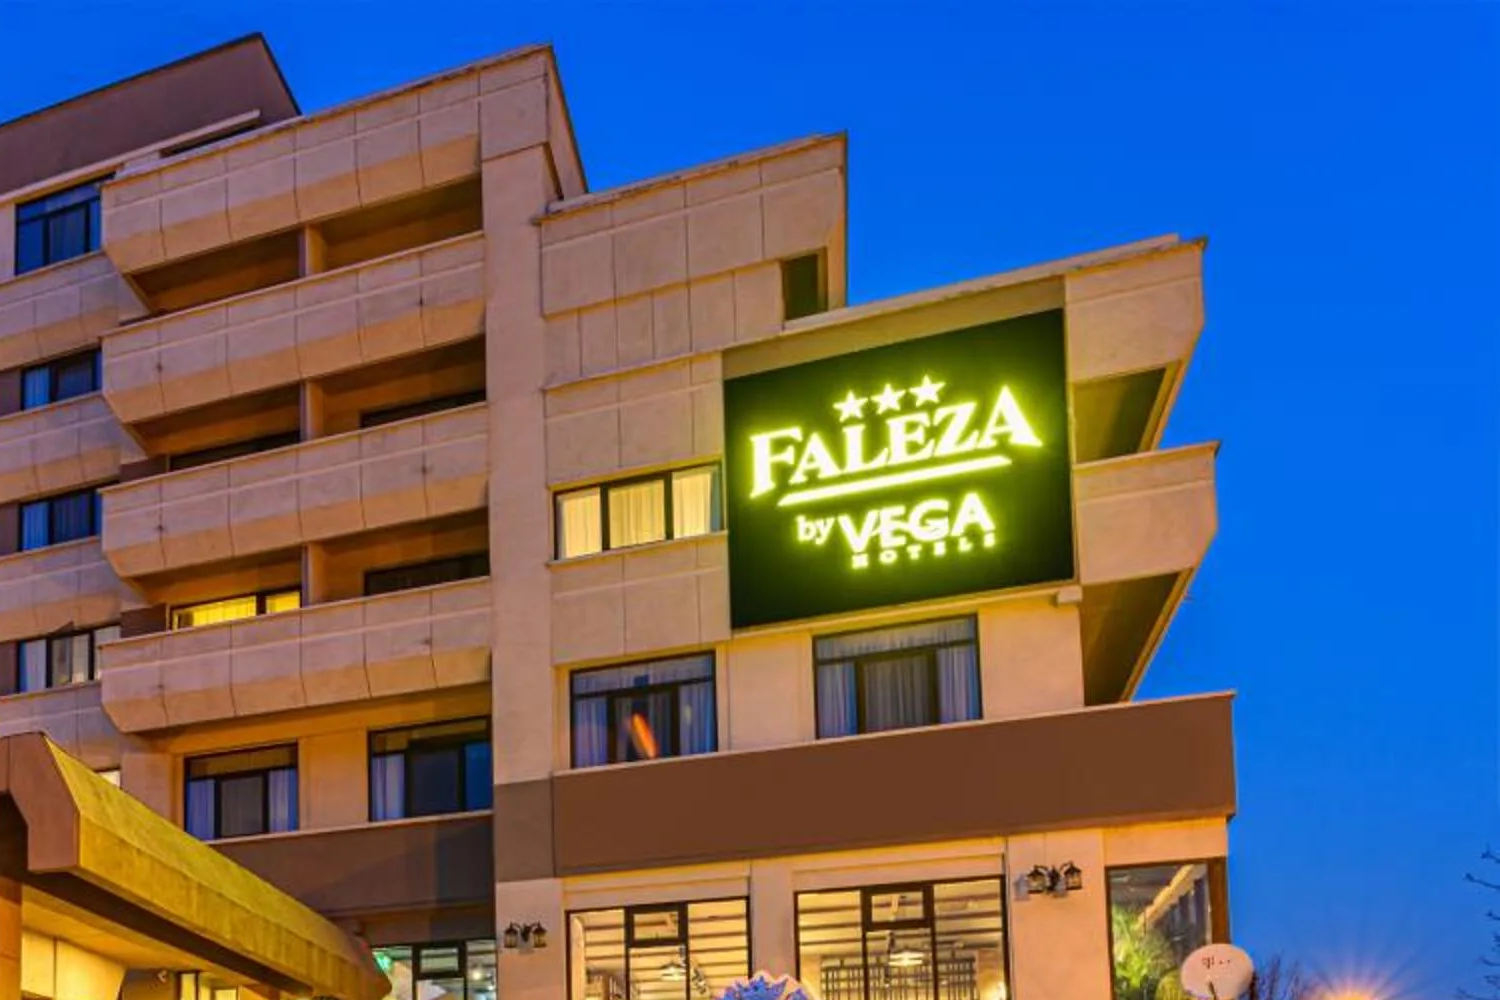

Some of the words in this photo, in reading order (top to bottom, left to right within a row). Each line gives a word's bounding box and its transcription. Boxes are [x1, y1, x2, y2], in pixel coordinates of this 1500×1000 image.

[750, 385, 1043, 499] FALEZA
[796, 515, 836, 545] by
[837, 493, 995, 552] VEGA
